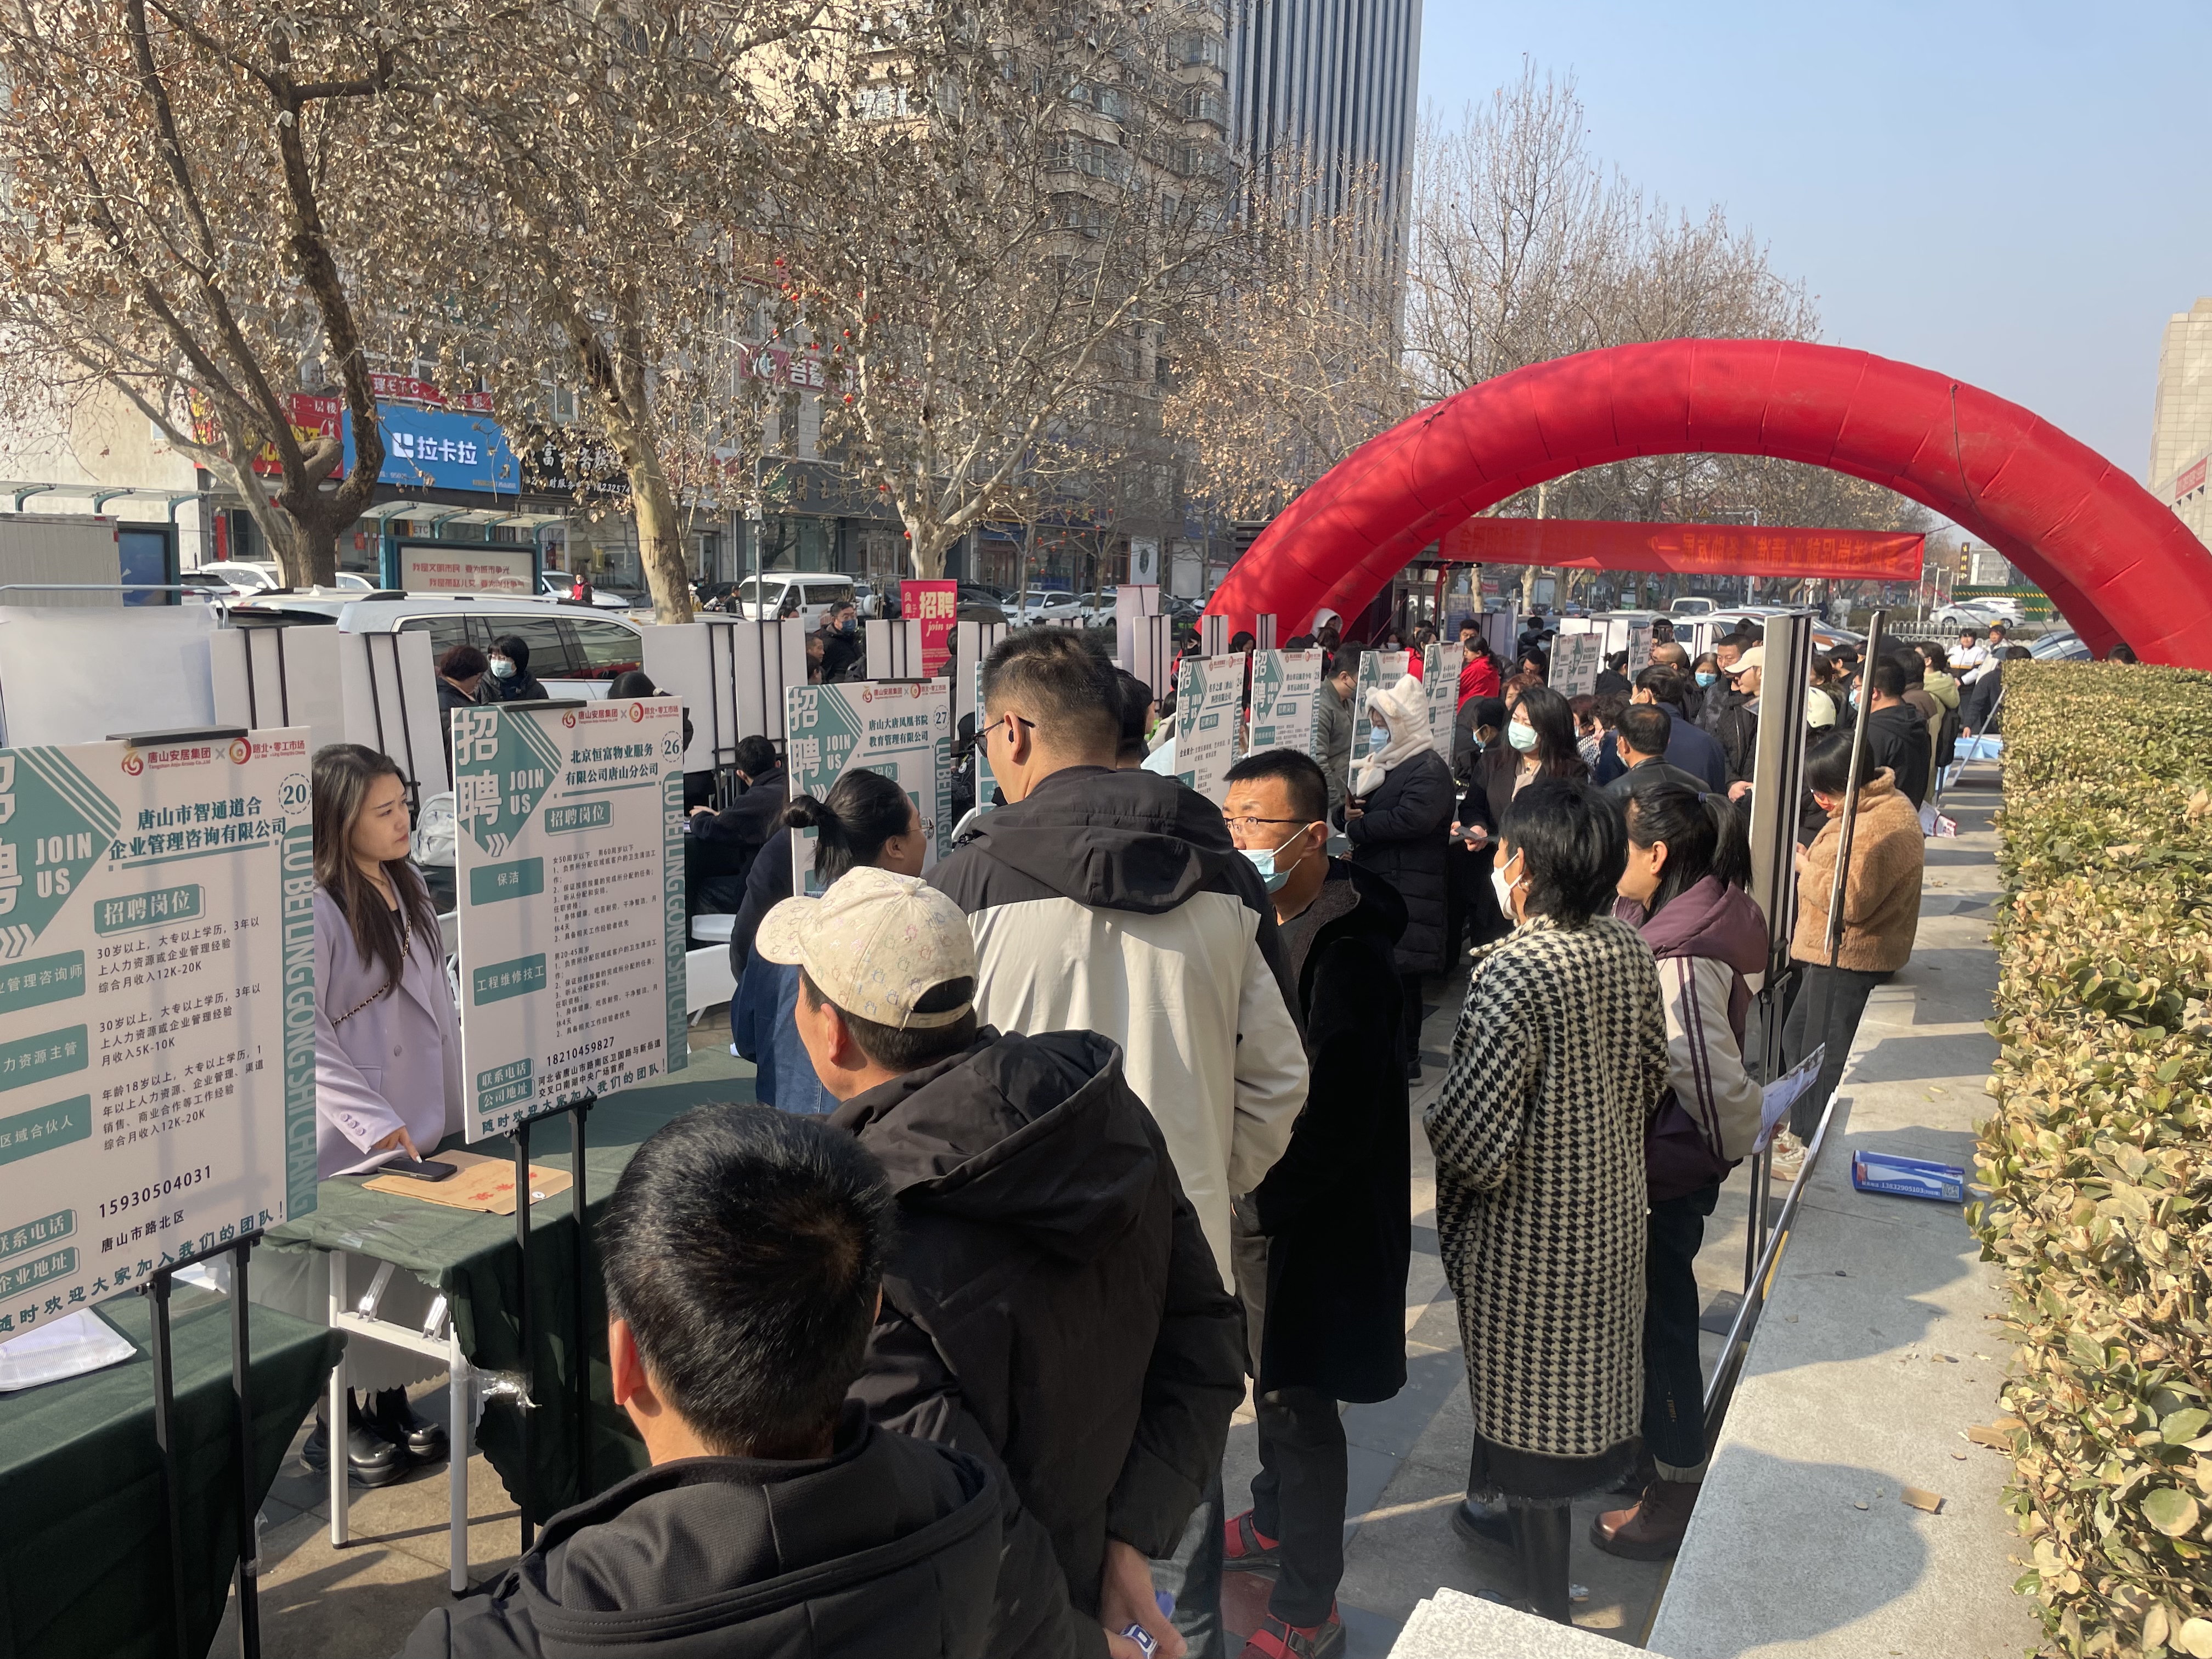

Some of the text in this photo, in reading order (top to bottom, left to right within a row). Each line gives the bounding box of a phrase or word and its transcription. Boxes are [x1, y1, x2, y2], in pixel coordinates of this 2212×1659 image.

[417, 435, 478, 465] 拉卡拉
[413, 562, 510, 575] 我是文明市民 要为城市争光
[919, 591, 955, 619] 招聘
[926, 620, 944, 637] join
[873, 687, 902, 696] 唐山安居集团
[1237, 677, 1243, 687] 24
[578, 708, 618, 720] 唐山安居集团
[868, 714, 929, 731] 唐山大唐凤凰书院
[935, 712, 947, 724] 27
[252, 740, 306, 754] 路北·零工市场
[664, 738, 680, 755] 26
[788, 688, 822, 778] 招聘
[826, 733, 851, 752] JOIN
[868, 730, 929, 748] 教育管理有限公司
[147, 747, 212, 764] 唐山安居集团
[454, 709, 503, 826] 招聘
[570, 742, 654, 765] 北京恒富物业服务
[827, 753, 842, 770] US
[936, 743, 951, 765] LU
[509, 768, 545, 792] JOIN
[565, 761, 658, 787] 有限公司唐山分公司
[937, 769, 952, 793] BEI
[283, 783, 307, 805] 20
[510, 793, 532, 816] US
[137, 795, 263, 832] 唐山市智通道合
[550, 804, 606, 828] 招聘岗位
[937, 795, 952, 834] LING
[35, 832, 92, 866] JOIN
[108, 816, 286, 861] 企业管理咨询有限公司
[552, 844, 634, 865] 女50周岁以下 男60周岁以下
[37, 867, 71, 898] US
[496, 870, 520, 887] 保洁
[104, 889, 191, 927] 招聘岗位
[664, 778, 688, 1069] LU BEI LING GONG SHI CHANG
[98, 938, 232, 977] 上人力资源或企业管理经验
[555, 945, 590, 961] 男20-45周岁
[98, 961, 202, 994] 综合月收入12K-20K
[476, 964, 545, 993] 工程维修技工
[100, 1005, 233, 1050] 上人力资源或企业管理经验
[282, 837, 318, 1216] LU BEI LING GONG SHI CHANG
[3, 1041, 77, 1073] 力资源主管
[101, 1037, 176, 1067] 月收入5K-10K
[546, 1036, 615, 1067] 18210459827
[103, 1059, 264, 1118] 年以上人力资源、企业管理、渠道
[481, 1062, 527, 1087] 联系电话
[538, 1061, 625, 1099] 交叉口南湖中央广场首府
[103, 1083, 235, 1135] 销售、商业合作等工作经验
[482, 1082, 528, 1108] 公司地址
[0, 1114, 74, 1148] 区域合伙人
[104, 1108, 206, 1152] 综合月收入12K-20K
[99, 1165, 212, 1218] 15930504031
[101, 1209, 185, 1254] 唐山市路北区
[0, 1252, 68, 1293] 企业地址
